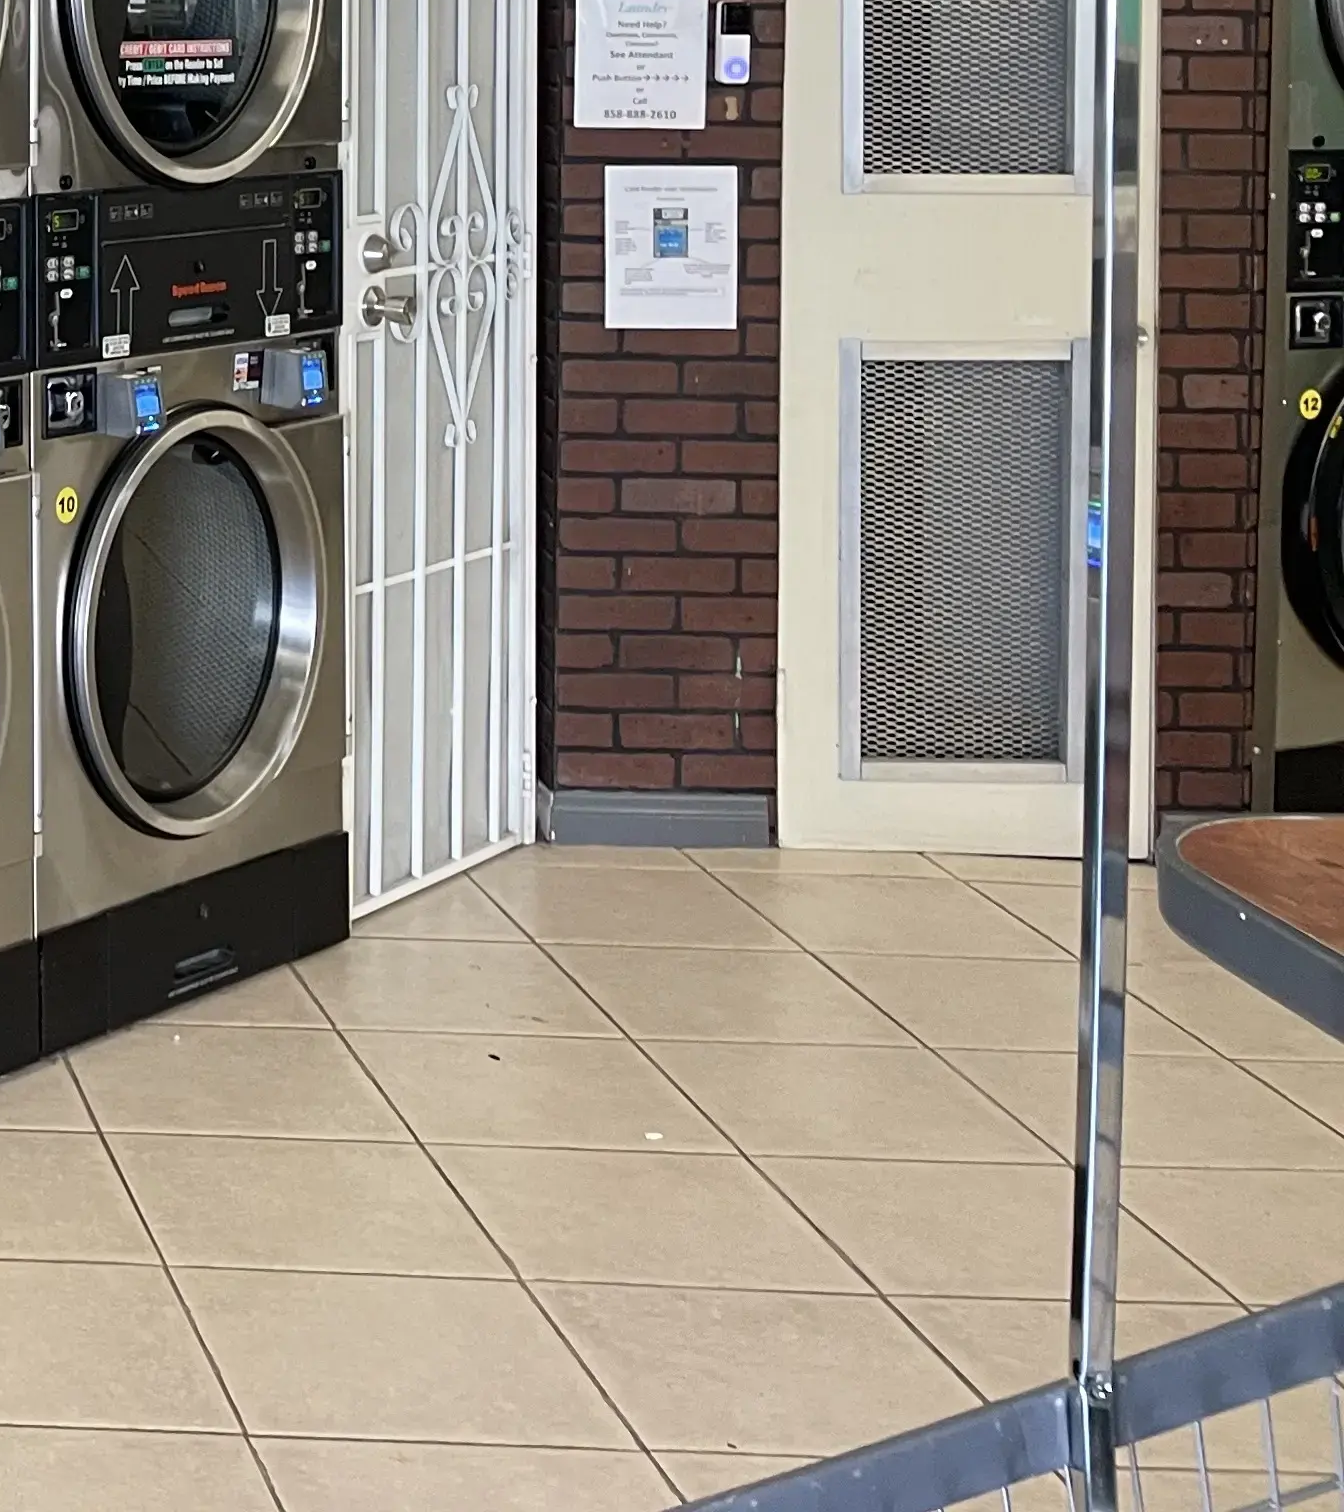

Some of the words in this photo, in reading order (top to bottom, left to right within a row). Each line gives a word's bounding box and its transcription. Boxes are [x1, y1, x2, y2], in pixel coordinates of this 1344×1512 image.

[618, 2, 670, 14] Laundry
[642, 21, 667, 30] Help?
[628, 51, 673, 59] Attendant
[614, 74, 642, 82] Button
[632, 97, 647, 105] Call
[1304, 398, 1318, 411] 12
[59, 496, 75, 514] 10
